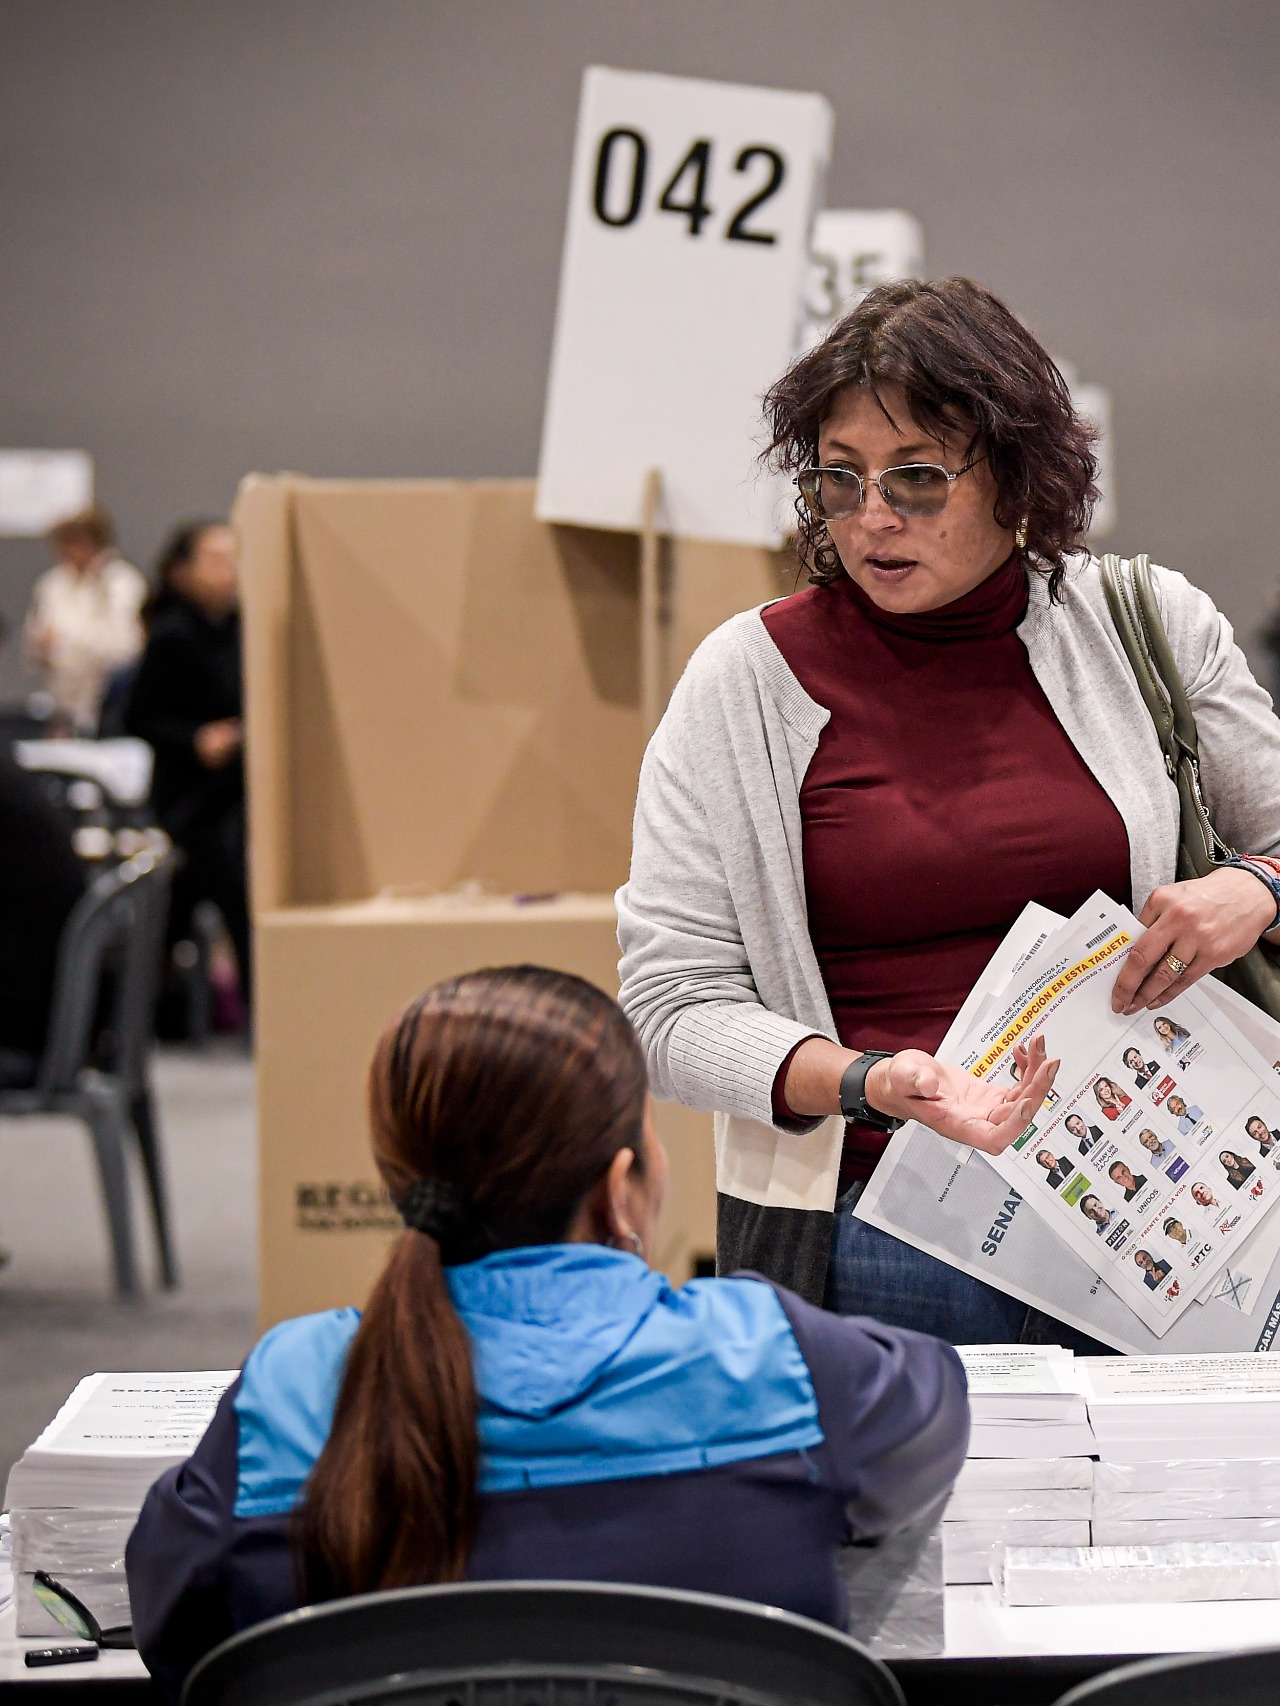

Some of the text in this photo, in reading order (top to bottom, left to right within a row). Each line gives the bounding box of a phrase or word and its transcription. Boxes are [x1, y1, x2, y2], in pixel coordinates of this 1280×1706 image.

[594, 127, 786, 245] 042
[972, 935, 1129, 1078] UE UNA SOLA OPCIÓN EN ESTA TARJETA
[979, 1013, 1006, 1043] CONSULTA
[1003, 1005, 1013, 1016] DE
[1011, 966, 1056, 1008] PRECANDIDATOS
[1059, 957, 1069, 965] LA
[985, 1062, 1005, 1084] NSULTA
[1003, 1055, 1011, 1063] DE
[1066, 969, 1098, 994] SEGURIDAD
[989, 1007, 1021, 1041] PRESIDENCIA
[1019, 998, 1028, 1007] DE
[1027, 992, 1036, 1000] LA
[1022, 1152, 1031, 1160] LA
[1029, 1136, 1044, 1152] GRAN
[1042, 1110, 1068, 1138] CONSULTA
[1066, 1098, 1078, 1110] POR
[1075, 1072, 1100, 1100] COLOMBIA
[937, 1163, 962, 1203] Mesa número
[1136, 1188, 1159, 1214] UNIDOS
[1140, 1216, 1159, 1238] FRENTE
[1157, 1204, 1169, 1216] POR
[1167, 1197, 1176, 1205] LA
[1174, 1185, 1187, 1196] VIDA
[1193, 1242, 1212, 1263] PTC
[1258, 1330, 1273, 1352] CAR
